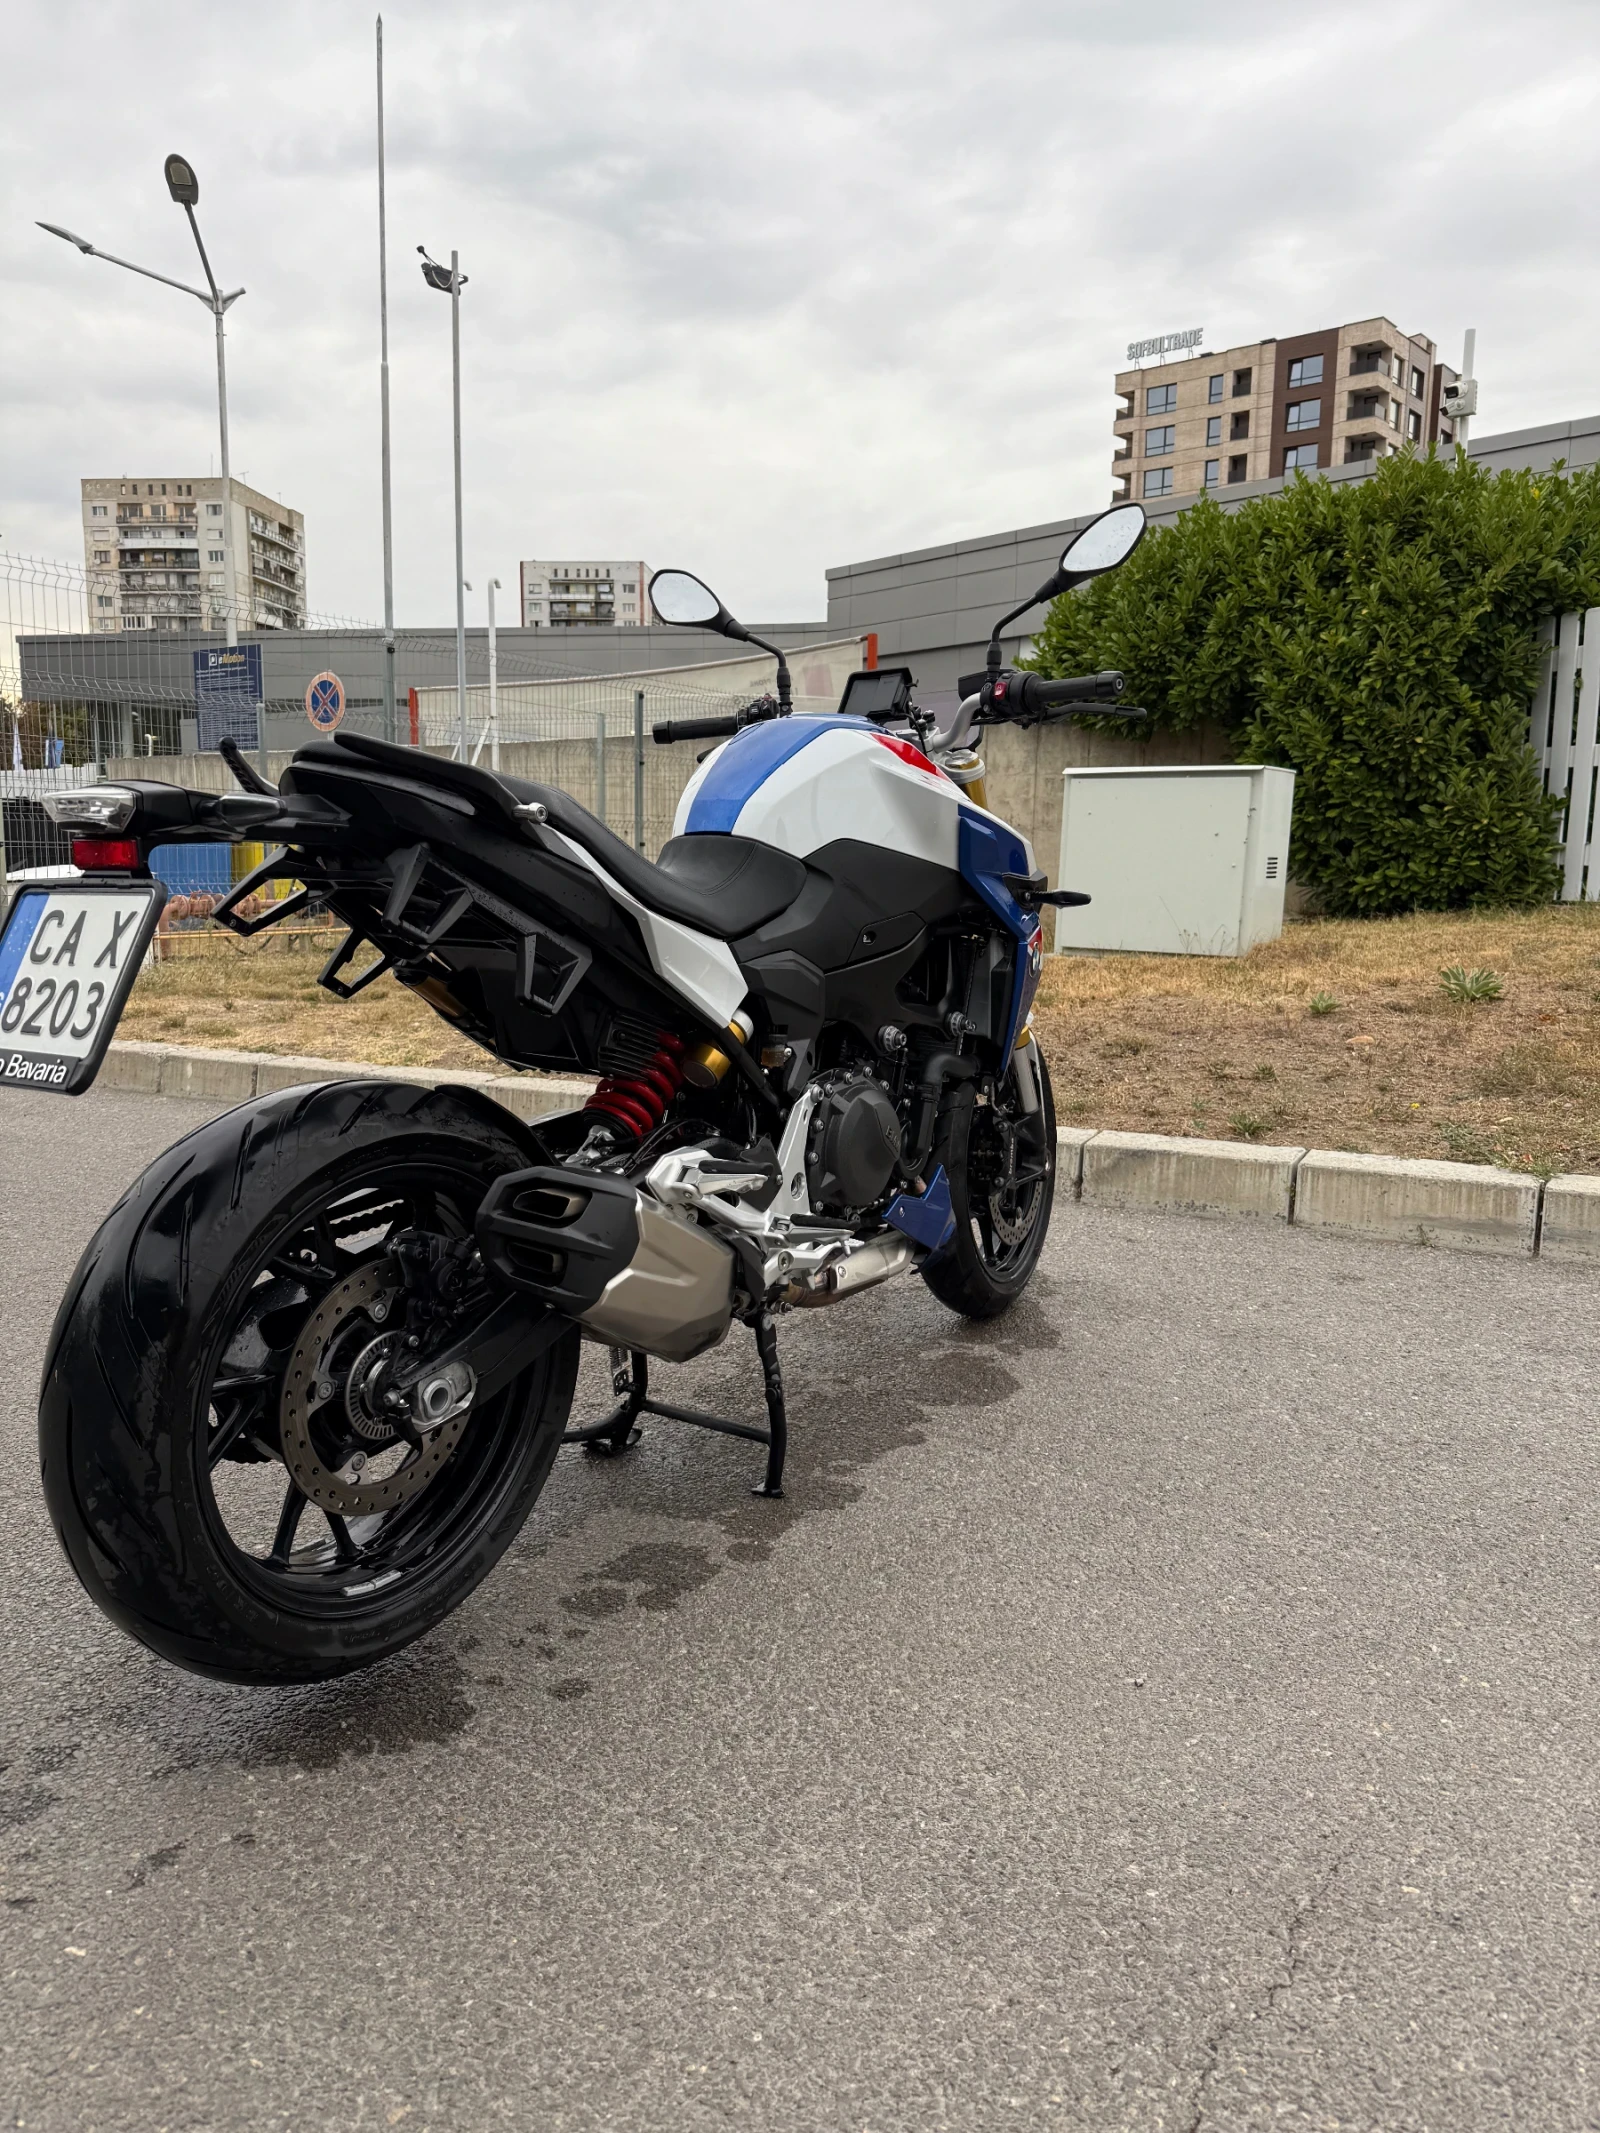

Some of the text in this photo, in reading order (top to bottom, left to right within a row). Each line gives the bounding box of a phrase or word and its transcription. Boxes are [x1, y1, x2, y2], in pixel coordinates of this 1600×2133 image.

[1127, 327, 1204, 360] SOFBULTRADE
[29, 909, 138, 968] CA X
[1, 976, 105, 1039] 8203
[5, 1053, 68, 1084] Bavaria
